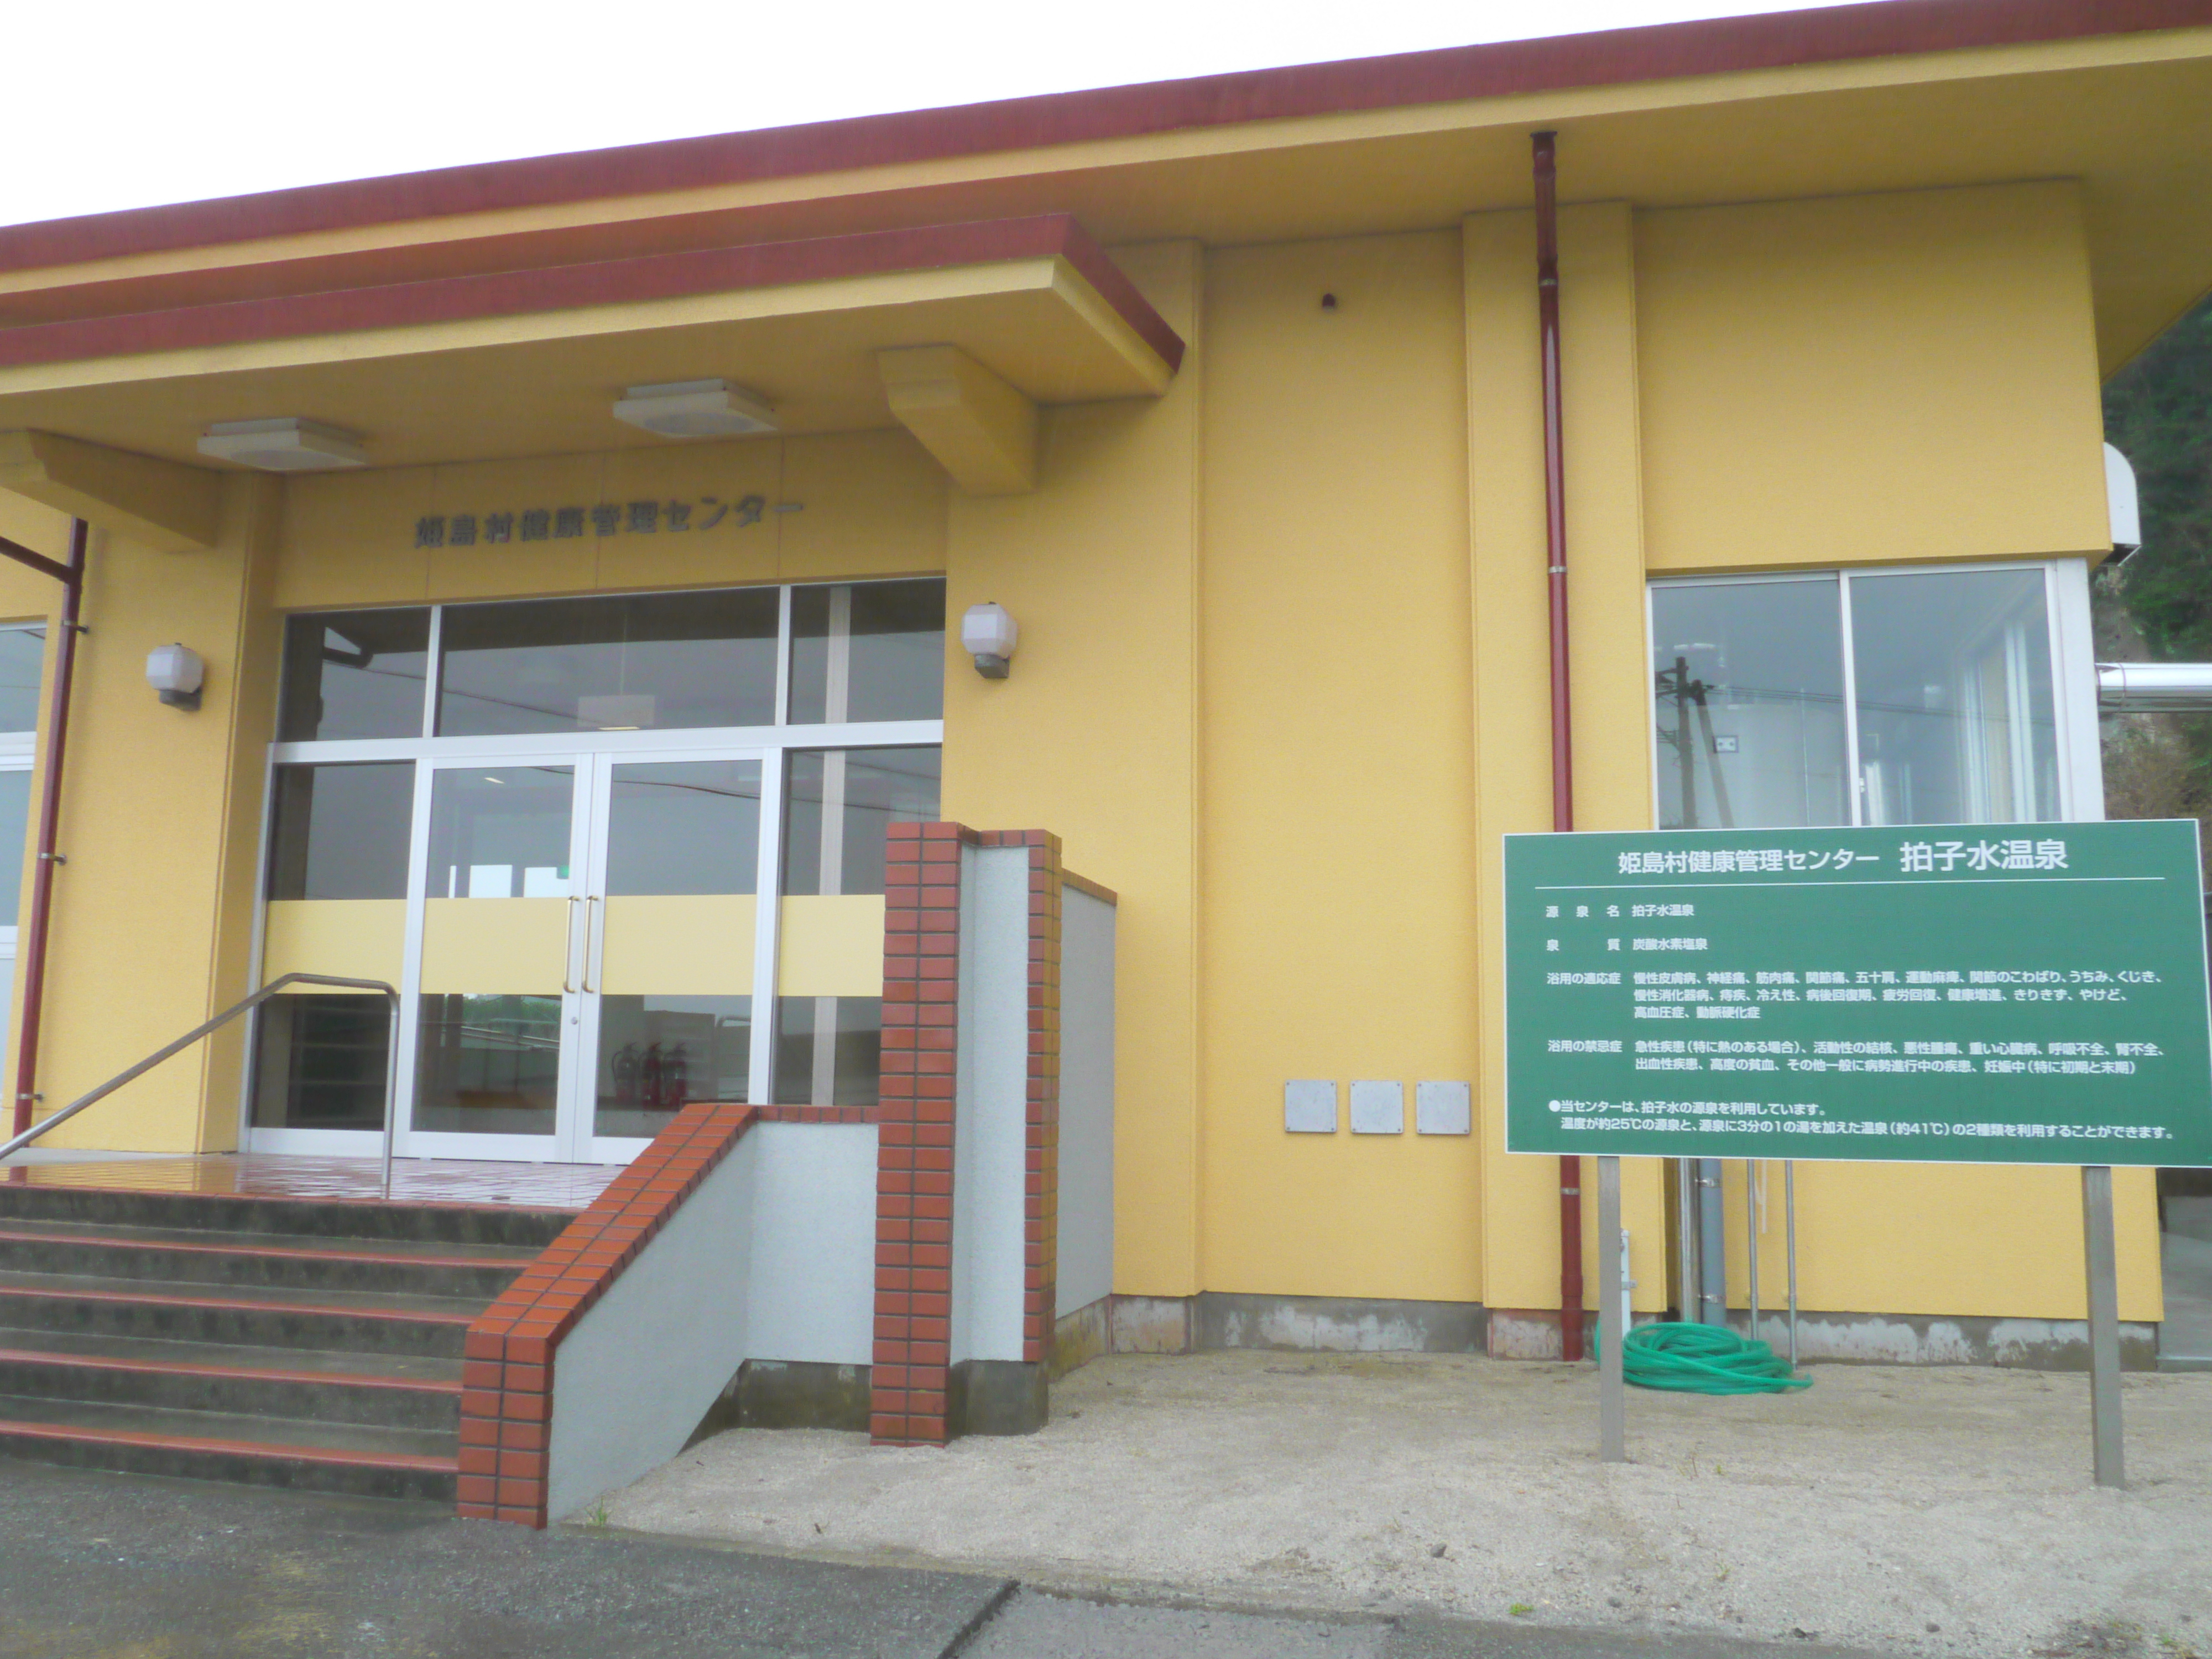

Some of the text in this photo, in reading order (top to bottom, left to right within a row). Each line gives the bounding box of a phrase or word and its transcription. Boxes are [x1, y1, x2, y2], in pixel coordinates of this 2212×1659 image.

[1618, 838, 2069, 874] 姫島村健康管理センター 拍子水温泉
[1632, 904, 1694, 917] 拍子水温泉
[1632, 937, 1708, 951] 炭酸水素塩泉
[1547, 972, 1621, 985] 浴用の適応症
[1548, 1040, 1623, 1053] 浴用の禁忌症
